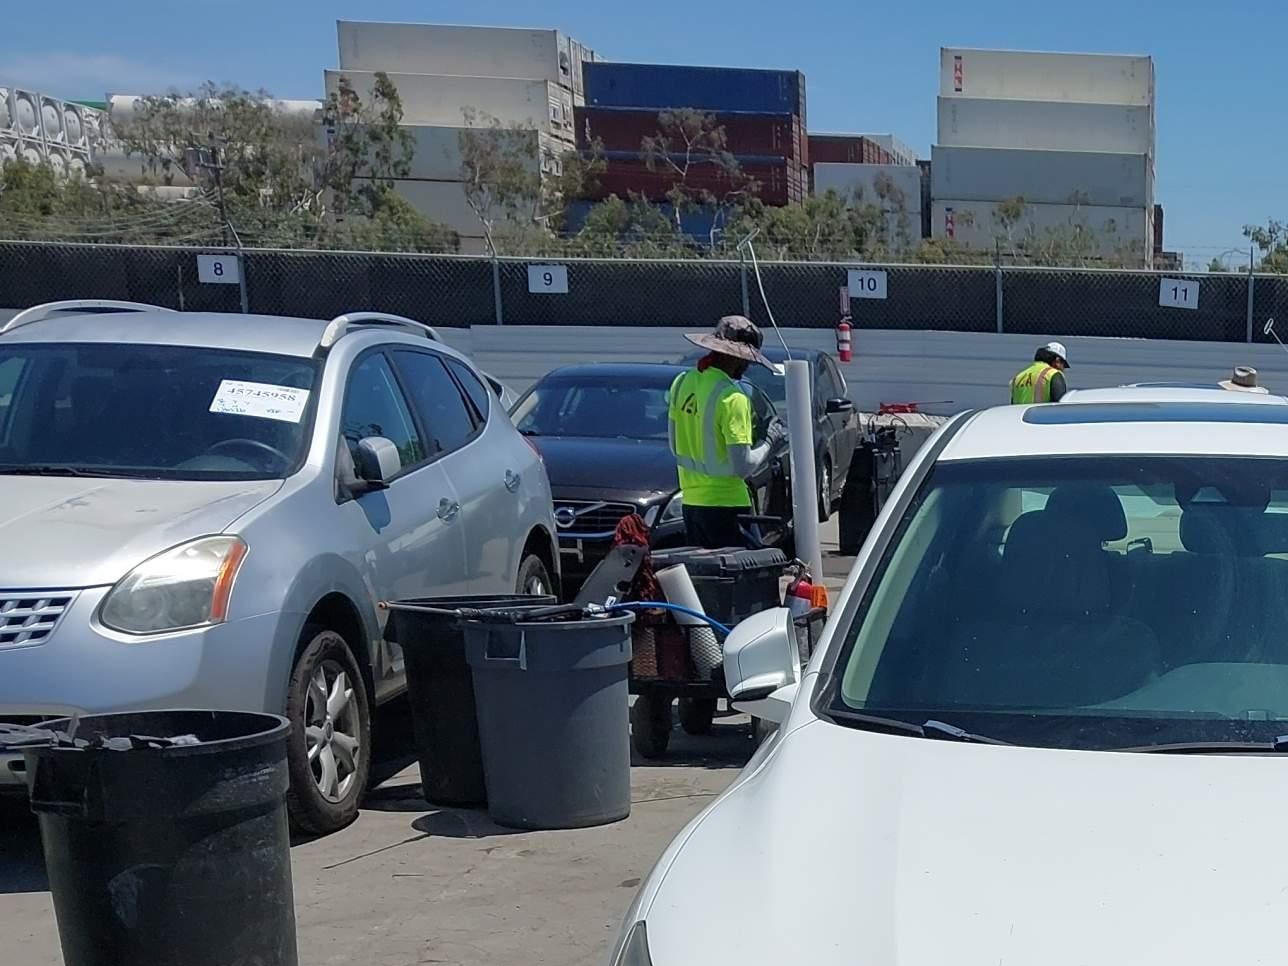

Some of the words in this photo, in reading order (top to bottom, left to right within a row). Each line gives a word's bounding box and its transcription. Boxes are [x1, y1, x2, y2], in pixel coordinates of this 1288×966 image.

[213, 262, 224, 277] 8
[543, 272, 553, 286] 9
[857, 277, 877, 292] 10
[1171, 286, 1188, 302] 11
[226, 387, 297, 401] 45745958
